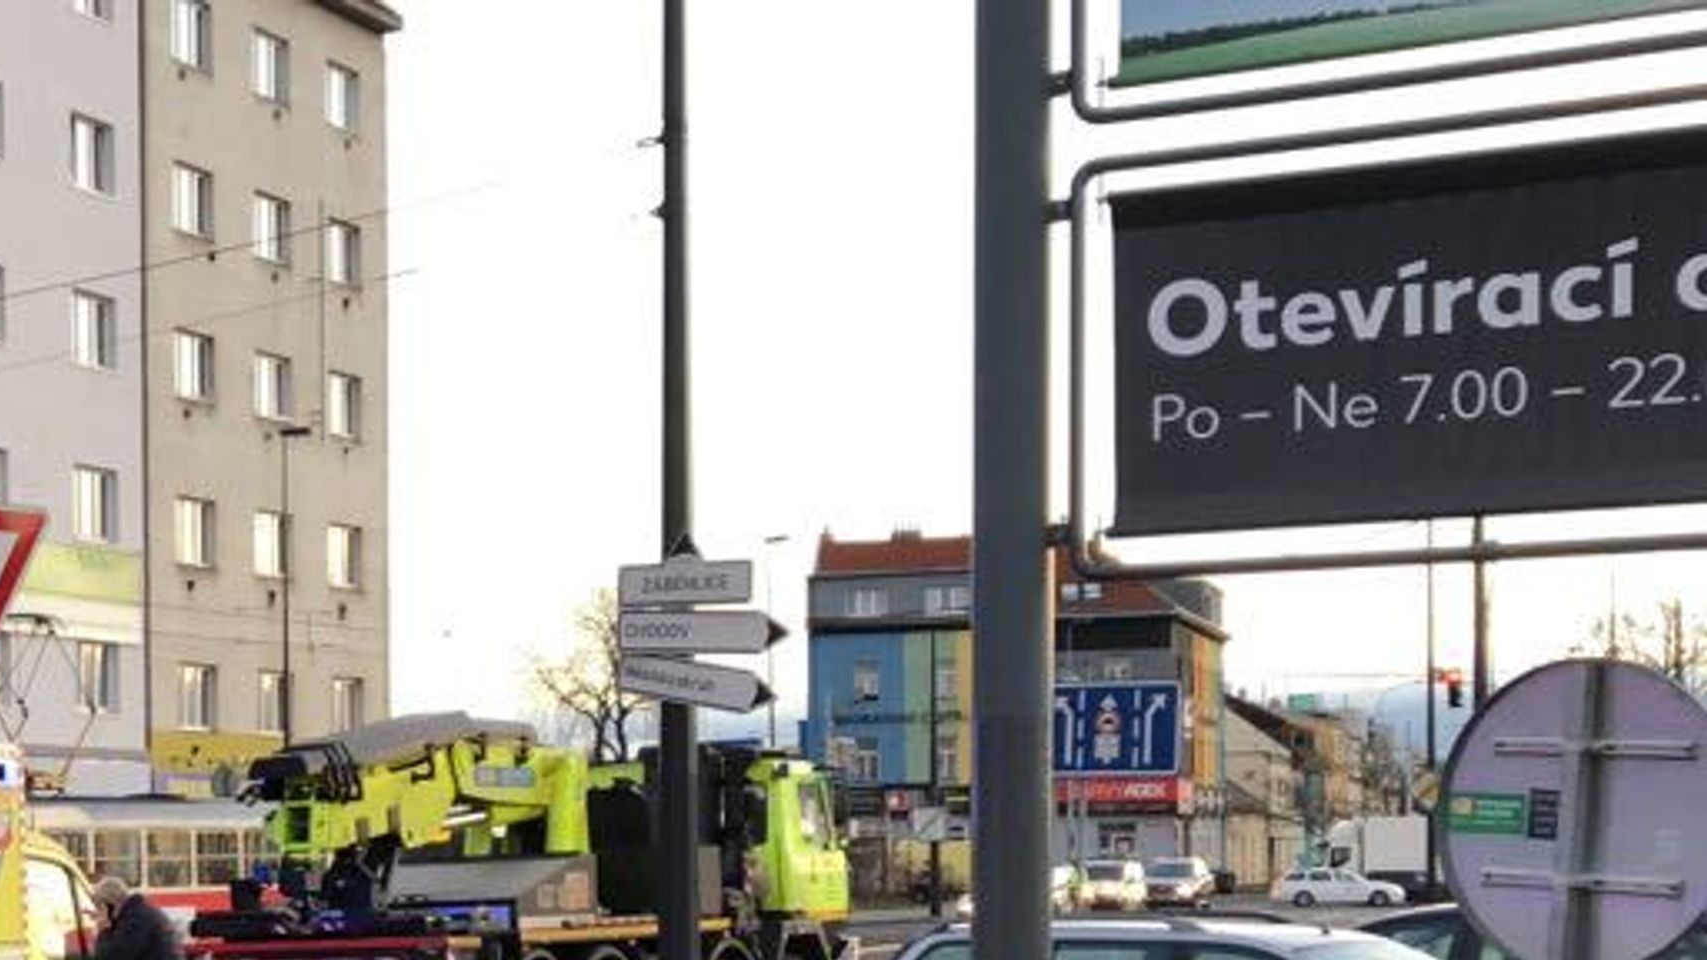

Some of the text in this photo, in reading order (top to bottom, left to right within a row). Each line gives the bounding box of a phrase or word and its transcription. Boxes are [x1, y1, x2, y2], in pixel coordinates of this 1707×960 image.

[1147, 237, 1639, 357] Otevírací
[1152, 394, 1221, 442] Po
[1294, 381, 1379, 433] Ne
[1400, 367, 1529, 425] 7.00
